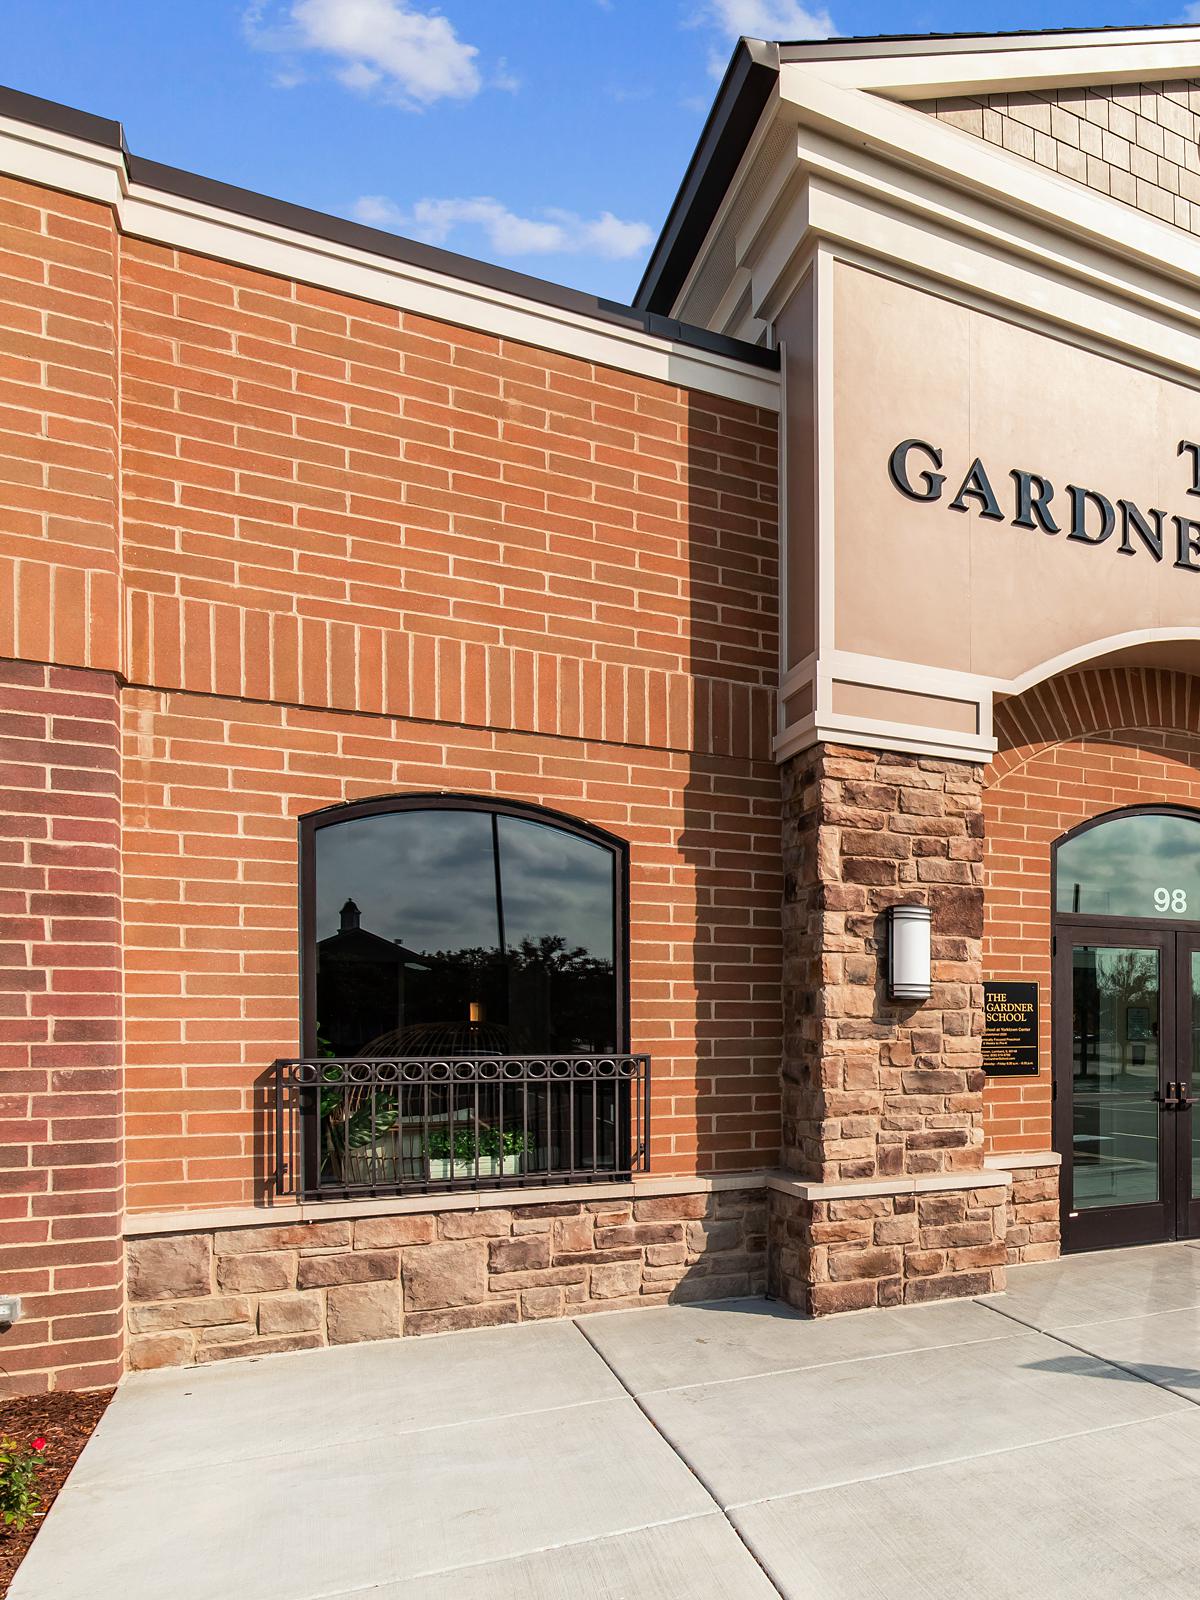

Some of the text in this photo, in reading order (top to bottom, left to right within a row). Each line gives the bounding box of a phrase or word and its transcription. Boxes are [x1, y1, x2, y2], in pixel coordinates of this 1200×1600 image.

[1153, 887, 1187, 914] 98
[986, 993, 1007, 1002] THE
[986, 1003, 1034, 1012] GARDNER
[986, 1013, 1027, 1022] SCHOOL
